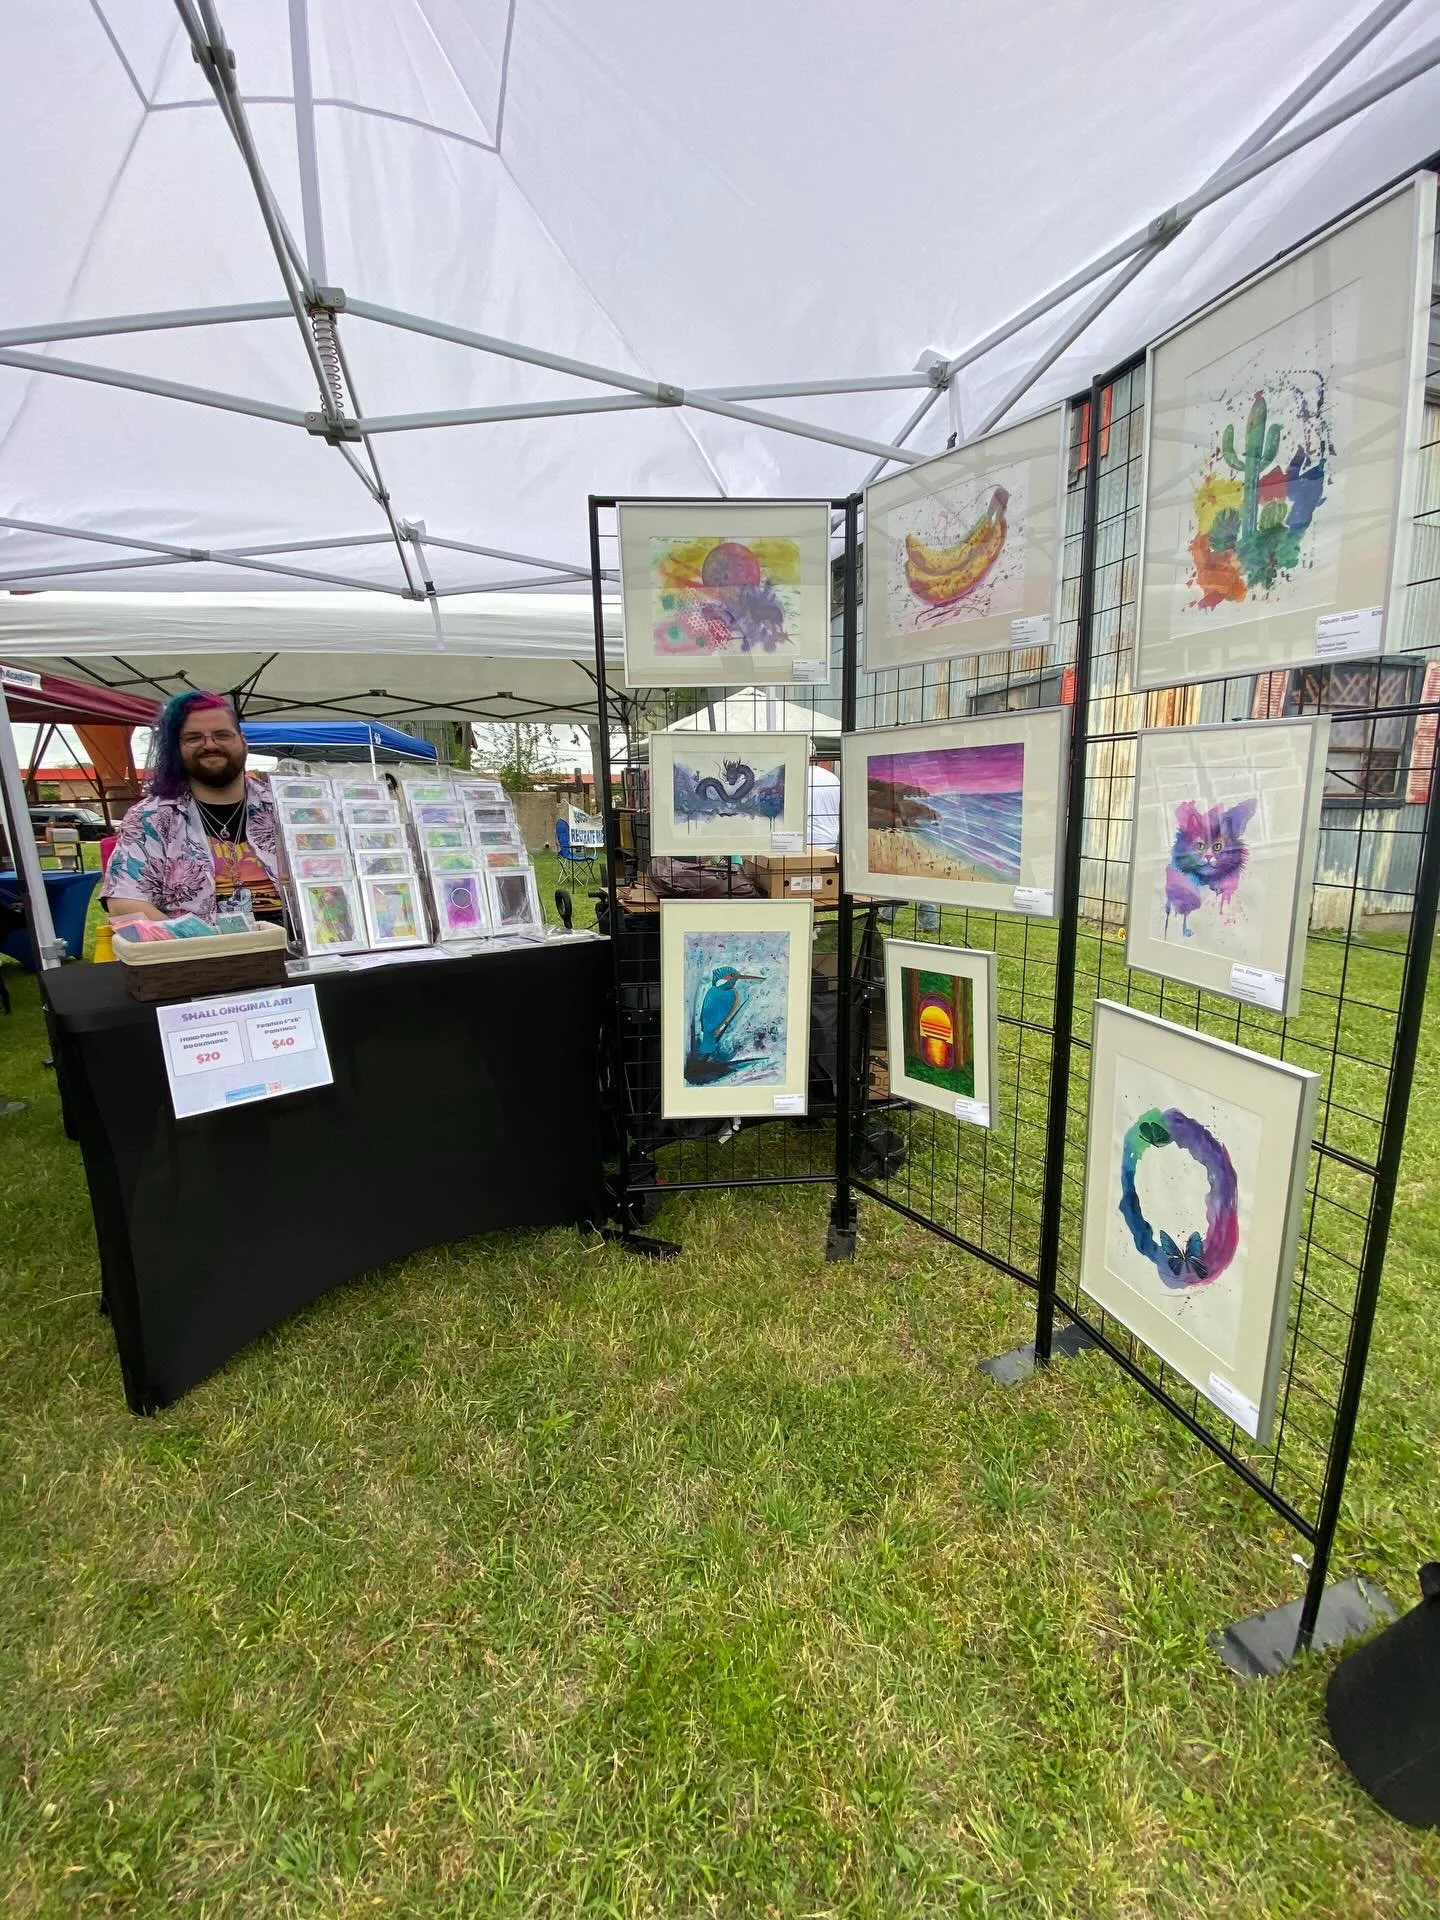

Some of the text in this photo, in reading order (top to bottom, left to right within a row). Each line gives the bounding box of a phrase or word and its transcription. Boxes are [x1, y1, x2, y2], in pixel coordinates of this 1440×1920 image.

[181, 997, 293, 1022] SMALL ORIGINAL ART
[272, 1037, 295, 1049] $40
[196, 1051, 221, 1065] $20
